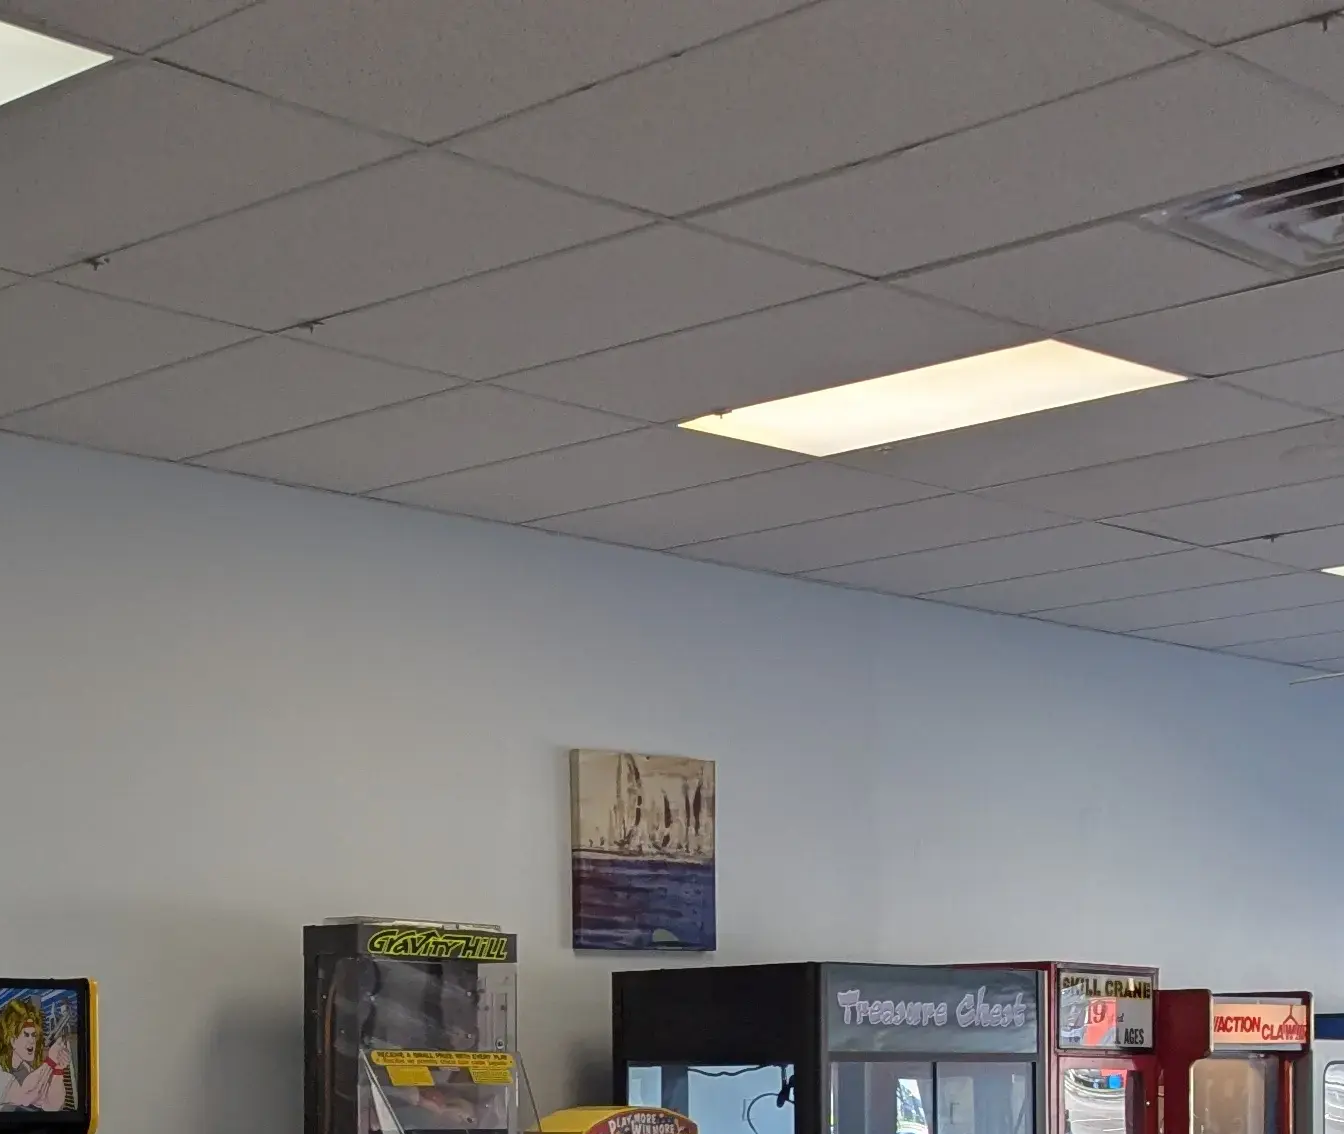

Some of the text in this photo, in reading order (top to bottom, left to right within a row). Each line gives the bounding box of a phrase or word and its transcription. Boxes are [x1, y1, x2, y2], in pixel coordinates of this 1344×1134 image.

[837, 985, 1027, 1028] Treasure Chest
[1123, 1028, 1145, 1045] AGES
[633, 1113, 657, 1124] MORE
